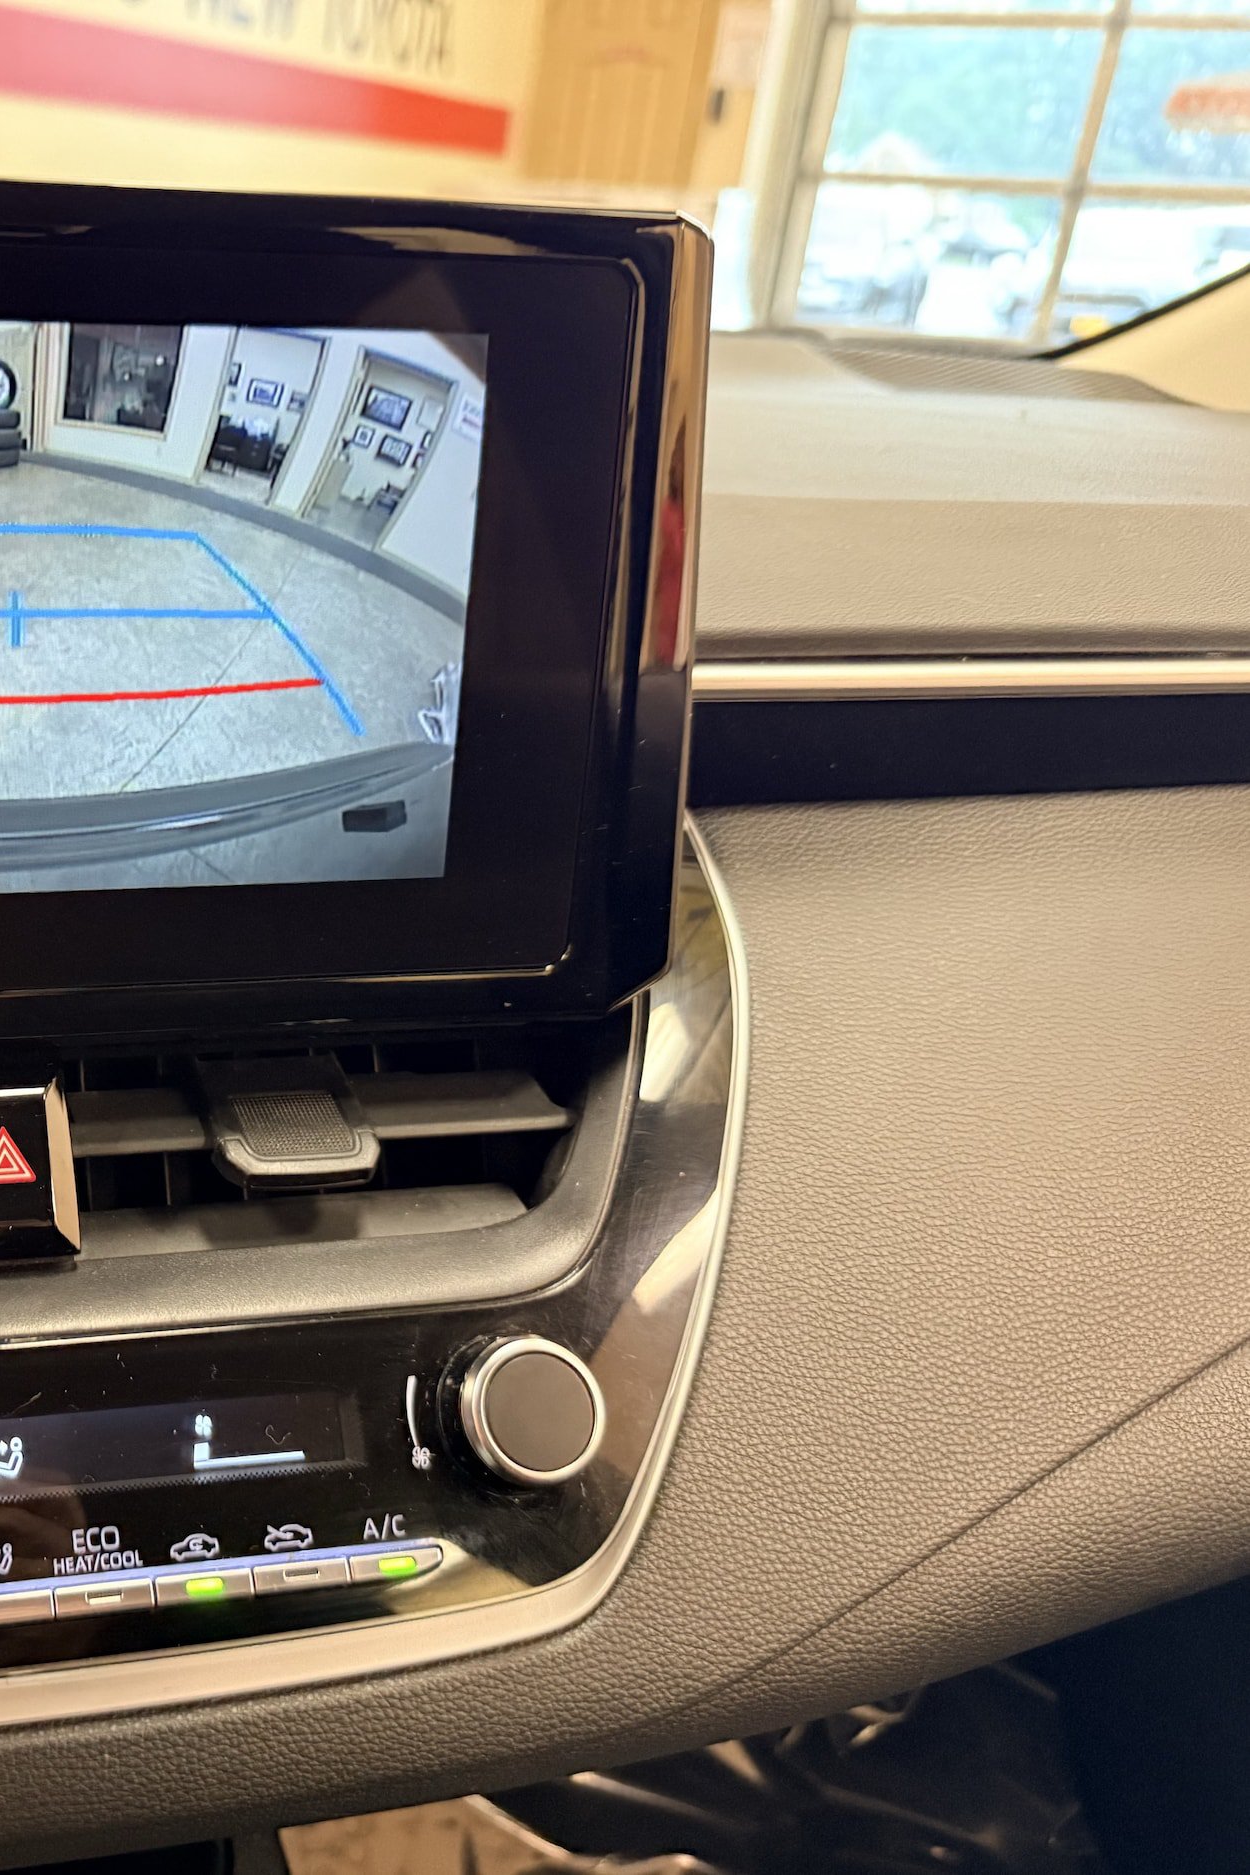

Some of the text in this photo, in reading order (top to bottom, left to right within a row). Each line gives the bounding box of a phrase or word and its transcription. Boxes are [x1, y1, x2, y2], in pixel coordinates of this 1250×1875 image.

[71, 1525, 120, 1555] ECO
[363, 1512, 406, 1540] A/C
[53, 1549, 144, 1576] HEAT/COOL
